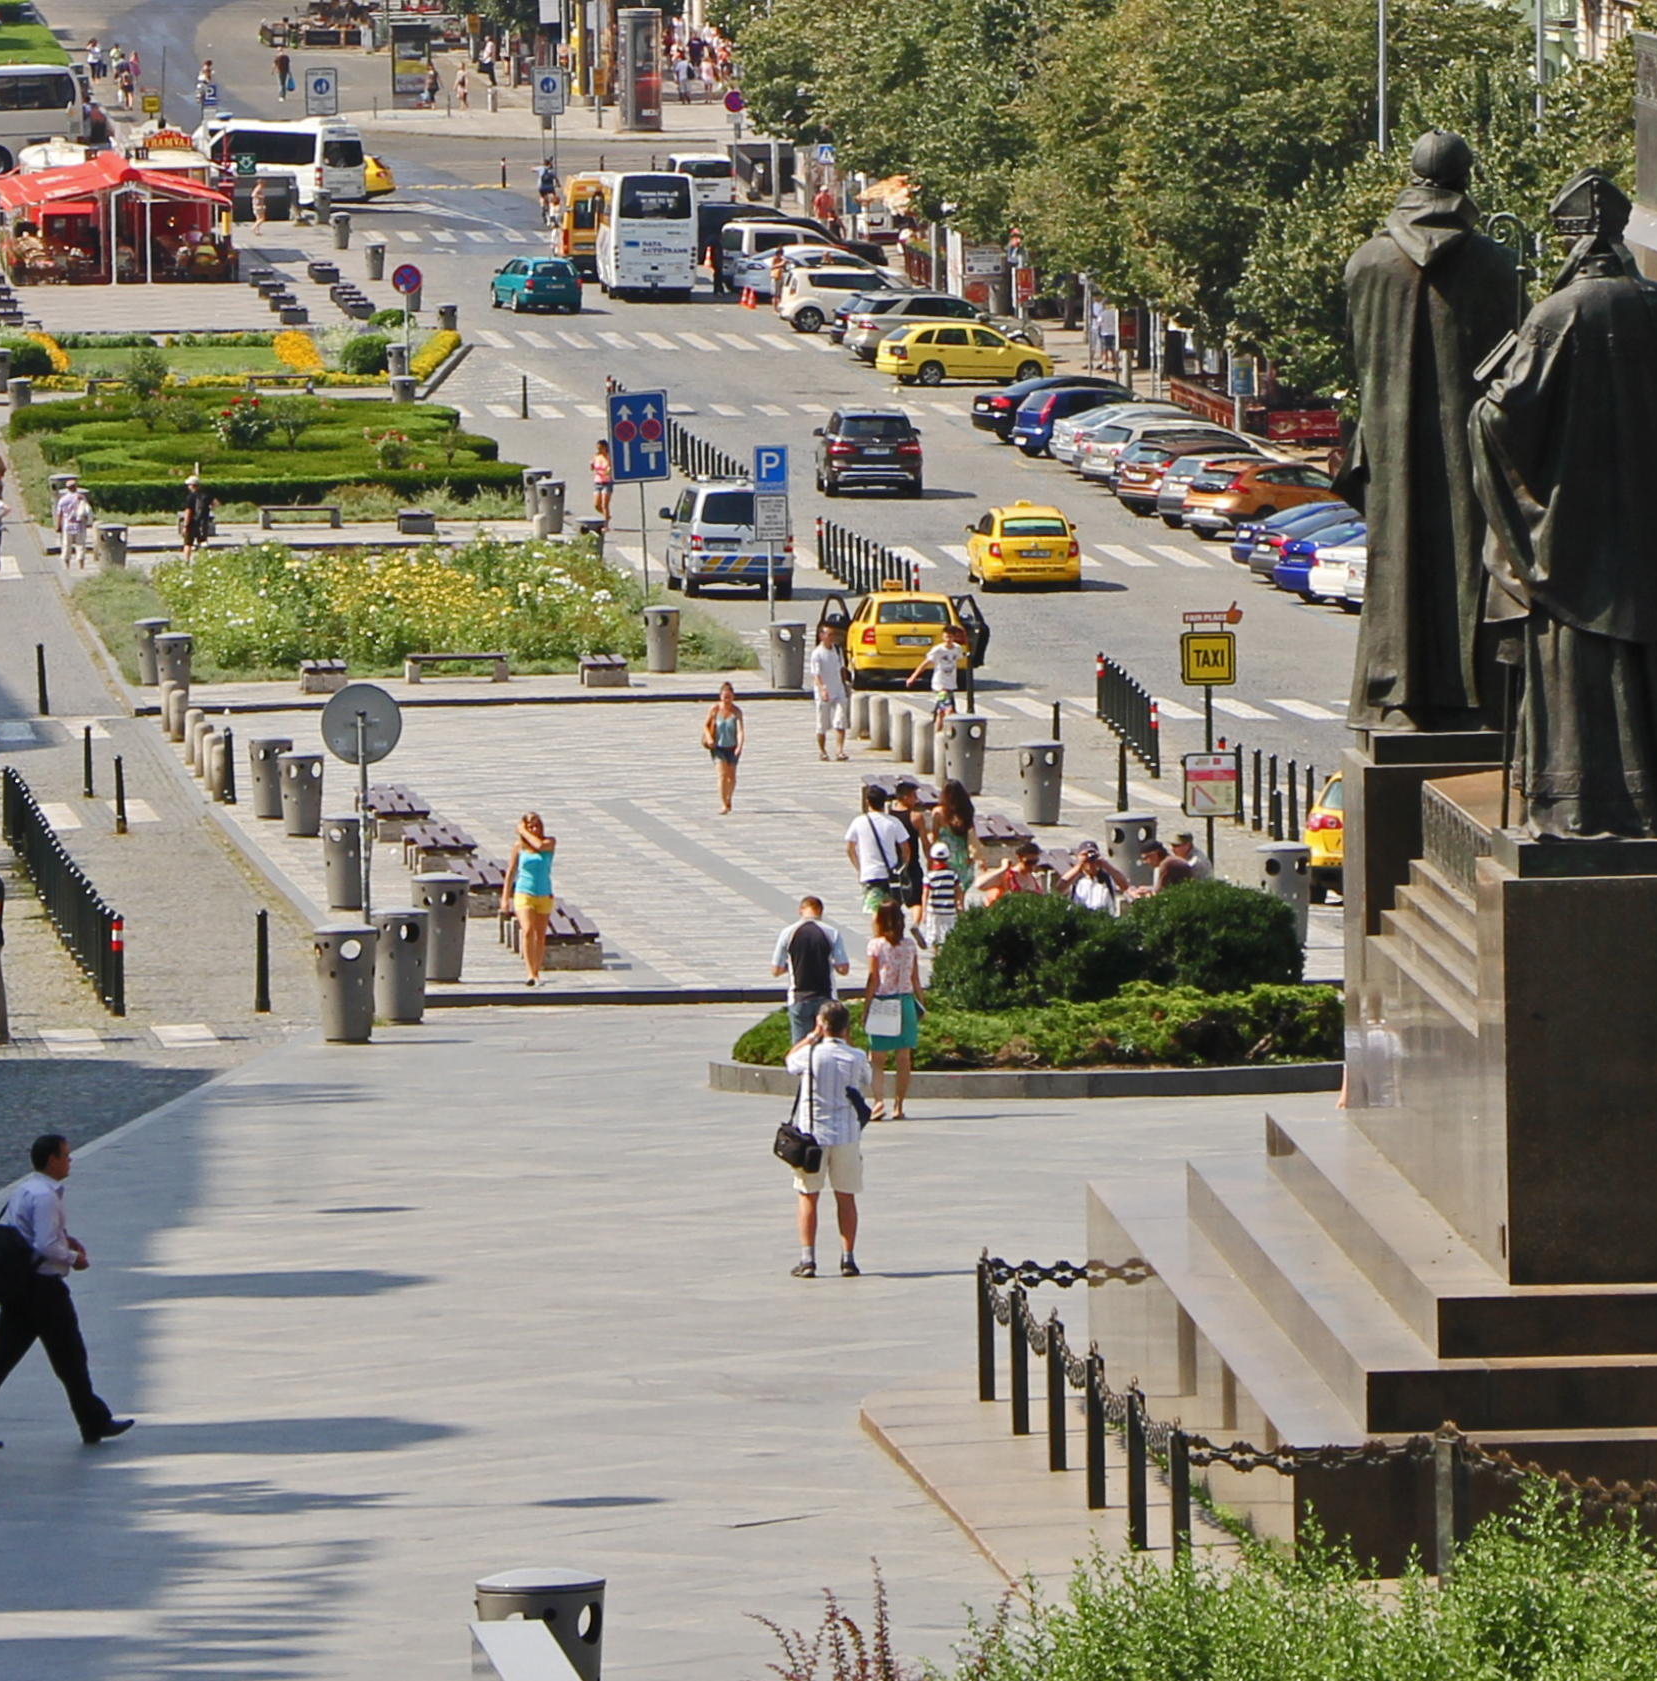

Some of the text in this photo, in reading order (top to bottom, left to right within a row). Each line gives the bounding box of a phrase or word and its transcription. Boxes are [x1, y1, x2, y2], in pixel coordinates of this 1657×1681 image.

[145, 137, 191, 148] TRAMVAJ
[761, 452, 780, 479] P
[1185, 613, 1228, 622] FAIR PLACE
[1193, 649, 1225, 668] TAXI
